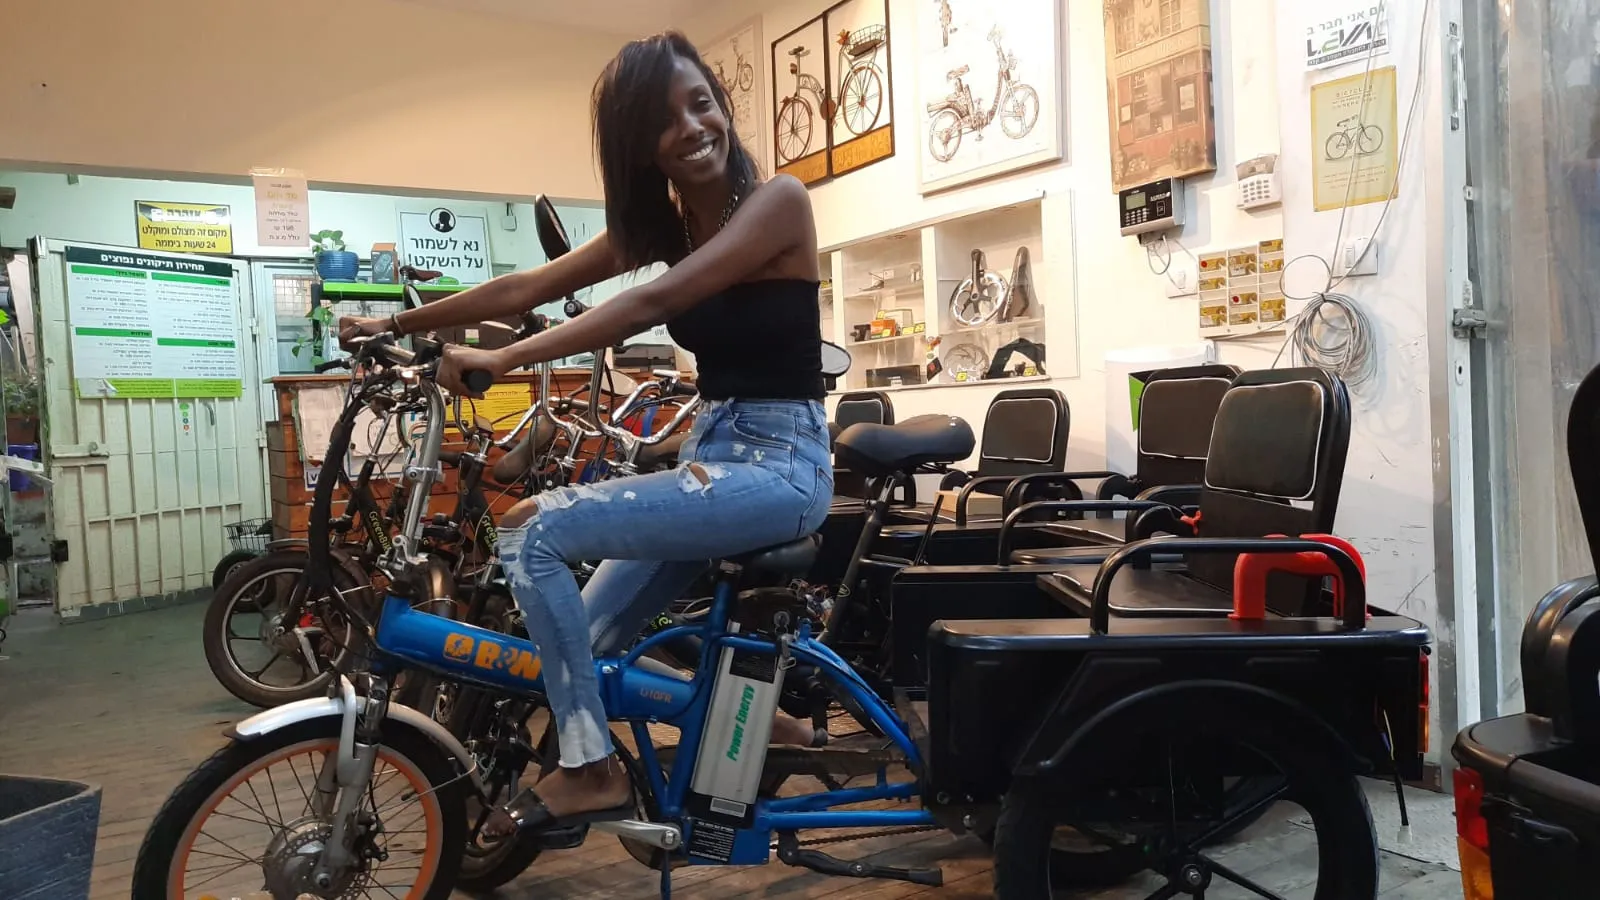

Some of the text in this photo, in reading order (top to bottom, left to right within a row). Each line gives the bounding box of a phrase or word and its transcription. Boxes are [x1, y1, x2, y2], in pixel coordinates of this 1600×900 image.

[1347, 10, 1365, 22] אני
[1306, 26, 1314, 35] ב
[1319, 17, 1342, 31] חבר
[142, 224, 227, 238] מקום זה מצולם ומוקלט
[155, 239, 181, 248] ביממה
[183, 241, 204, 249] שעות
[410, 237, 479, 251] נא לשמור
[100, 253, 204, 271] מחירון תיקונים נפוצים
[464, 254, 483, 268] על
[726, 722, 744, 761] Power
[735, 683, 755, 725] Energy
